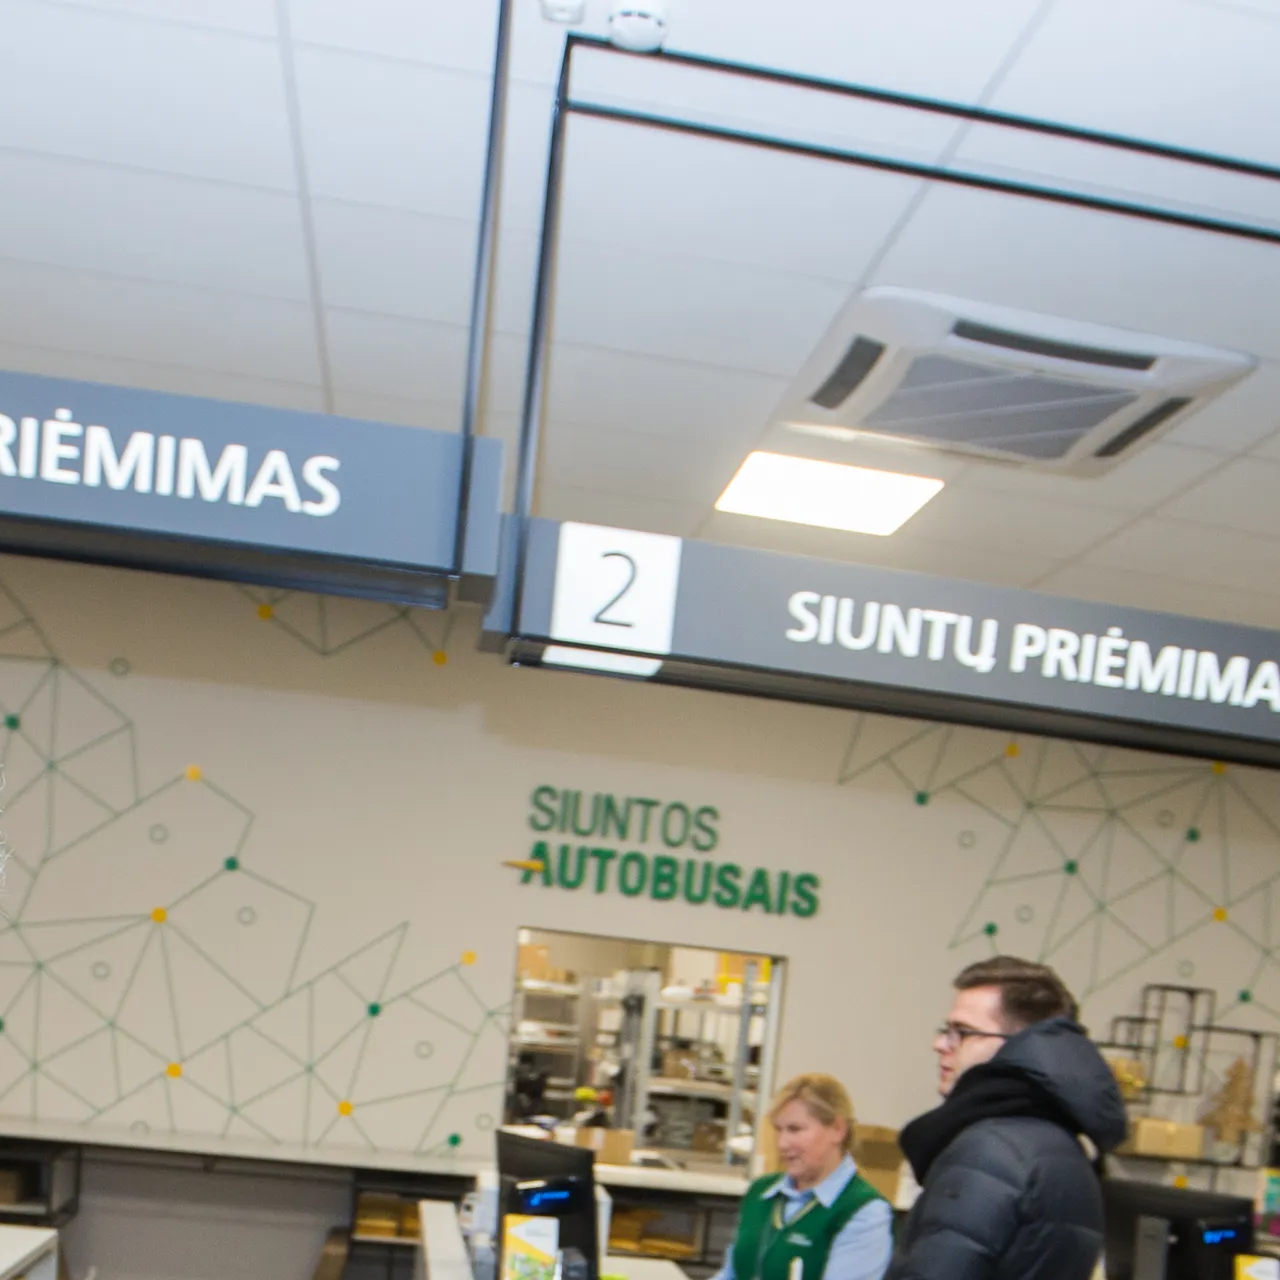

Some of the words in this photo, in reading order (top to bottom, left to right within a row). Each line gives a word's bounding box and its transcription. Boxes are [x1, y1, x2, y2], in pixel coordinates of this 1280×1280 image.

[592, 551, 638, 628] 2
[785, 590, 999, 673] SIUNTŲ
[528, 784, 721, 851] SIUNTOS
[520, 840, 821, 918] AUTOBUSAIS
